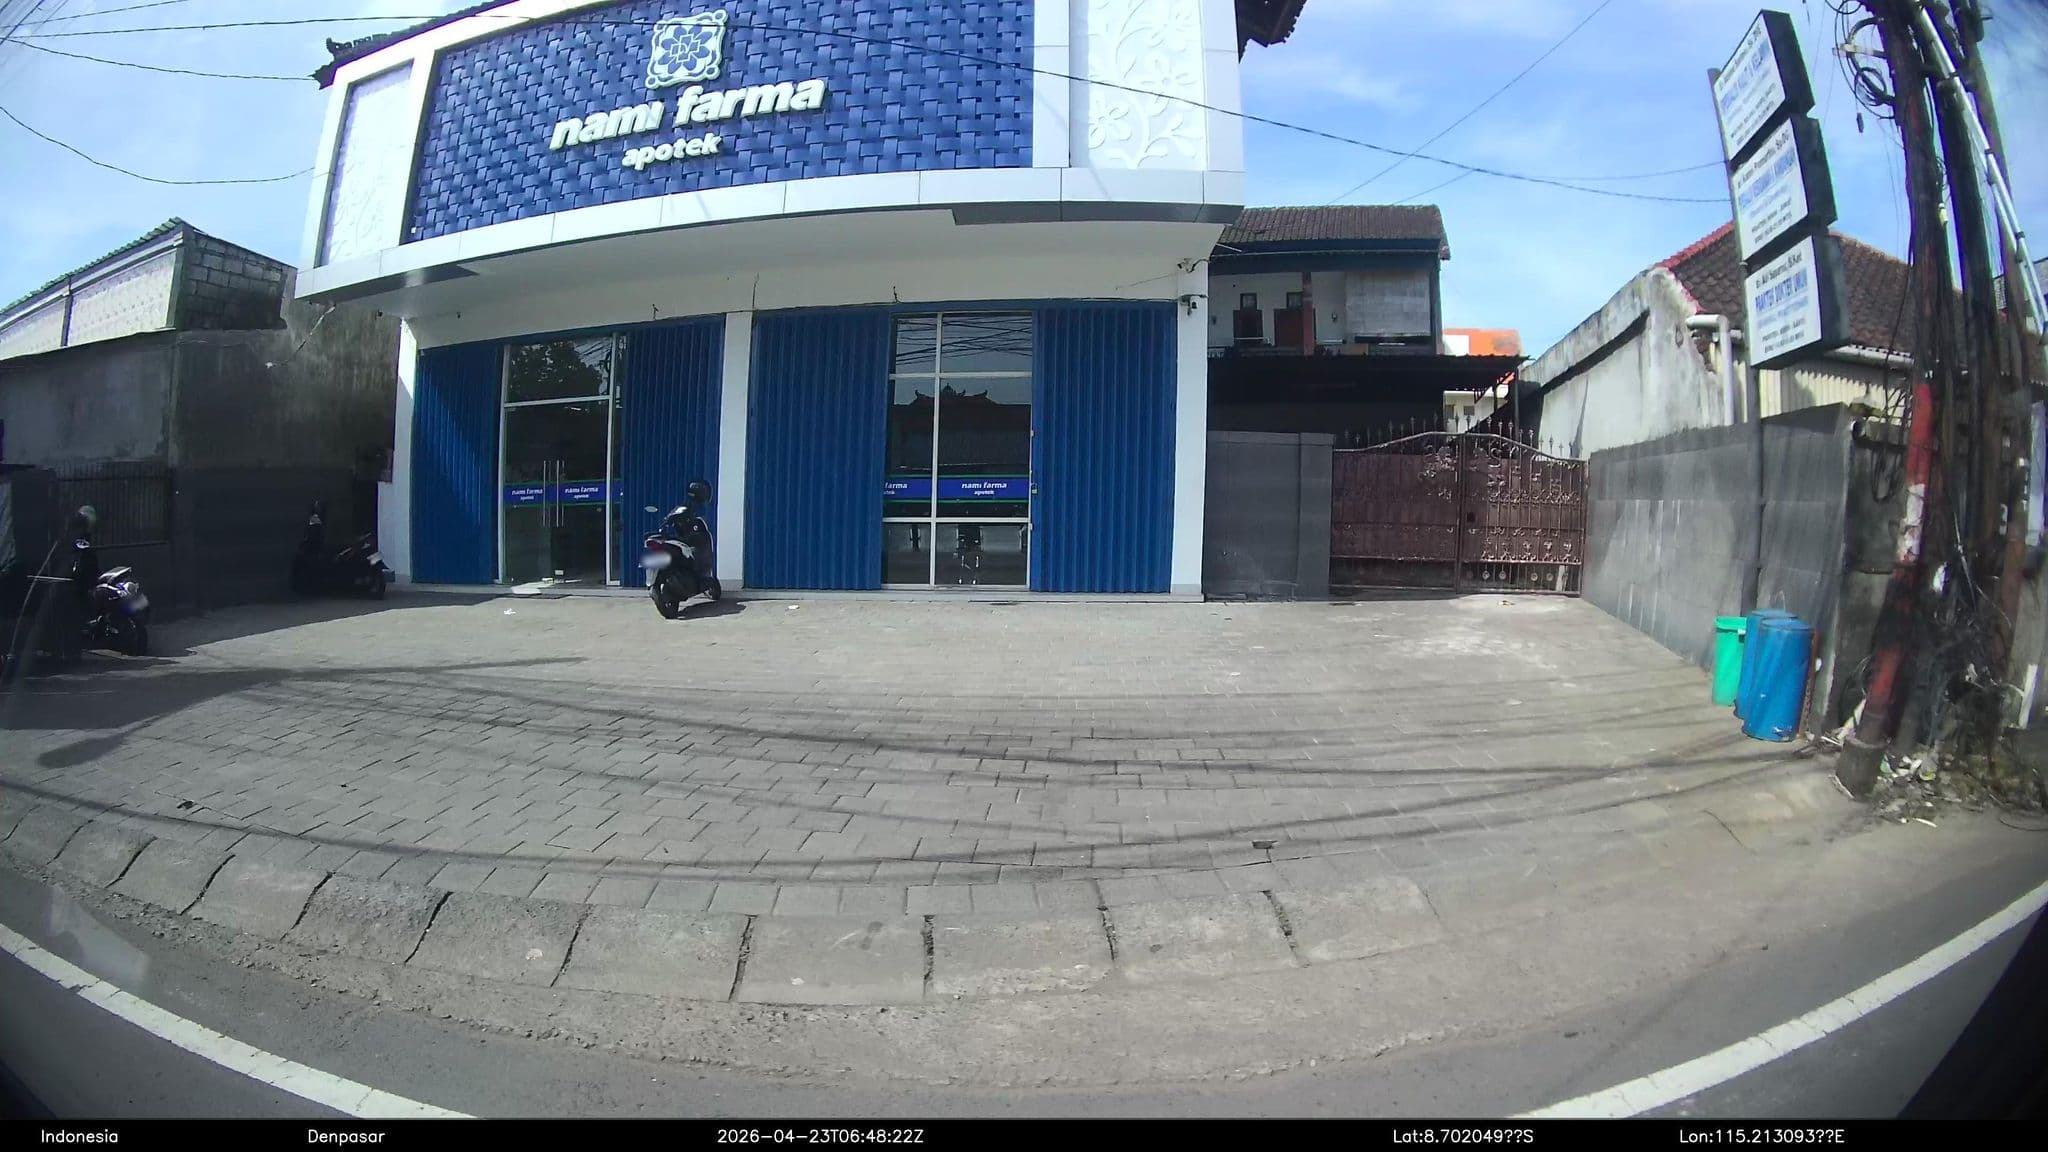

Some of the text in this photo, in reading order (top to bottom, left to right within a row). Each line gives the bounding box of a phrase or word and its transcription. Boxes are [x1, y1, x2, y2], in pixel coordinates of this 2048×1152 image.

[549, 79, 826, 151] nami farma
[621, 132, 723, 171] apotek
[983, 481, 1007, 489] farma
